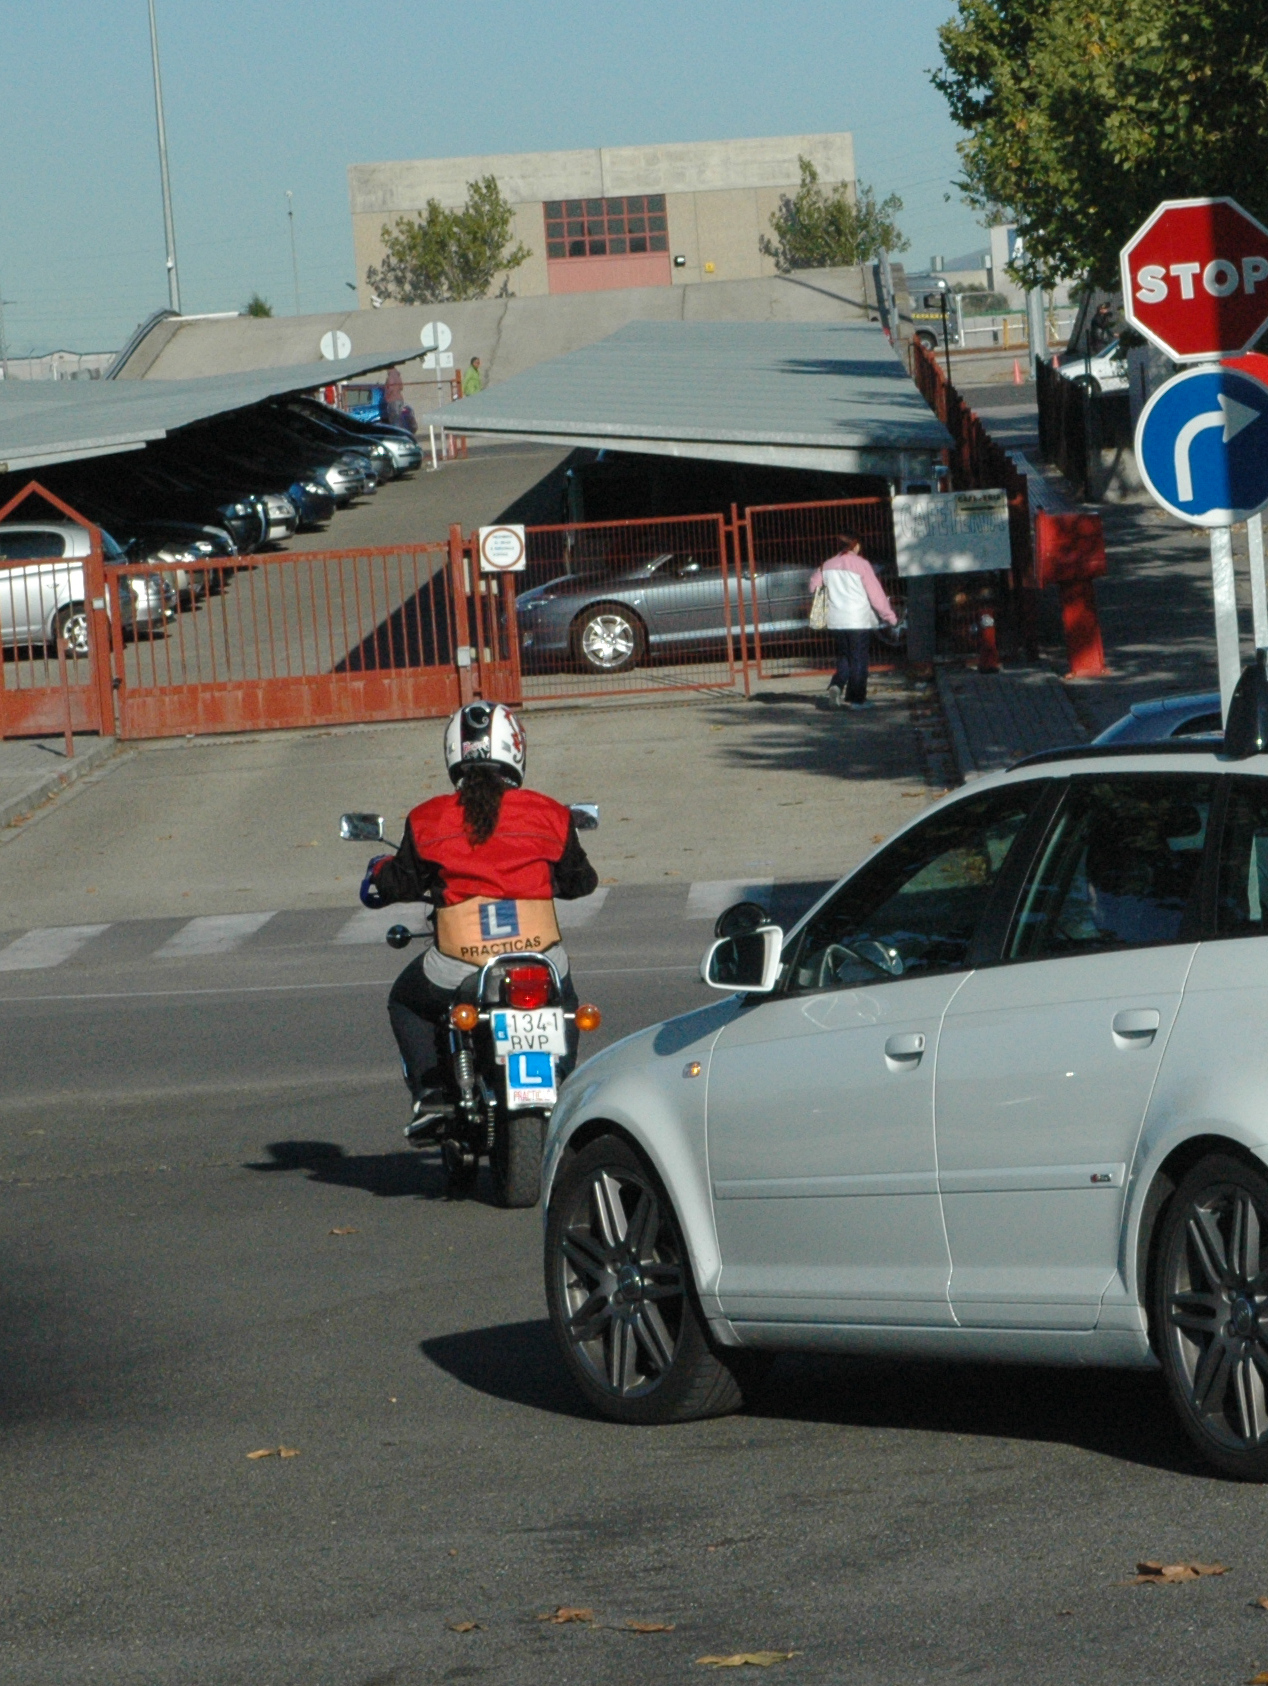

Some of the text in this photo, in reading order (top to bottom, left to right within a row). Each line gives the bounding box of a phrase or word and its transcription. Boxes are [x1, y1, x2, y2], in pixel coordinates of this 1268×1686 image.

[487, 904, 512, 936] L
[460, 936, 542, 957] PRACTICAS
[511, 1012, 559, 1033] 1341
[511, 1035, 549, 1050] RVP
[519, 1054, 543, 1084] L
